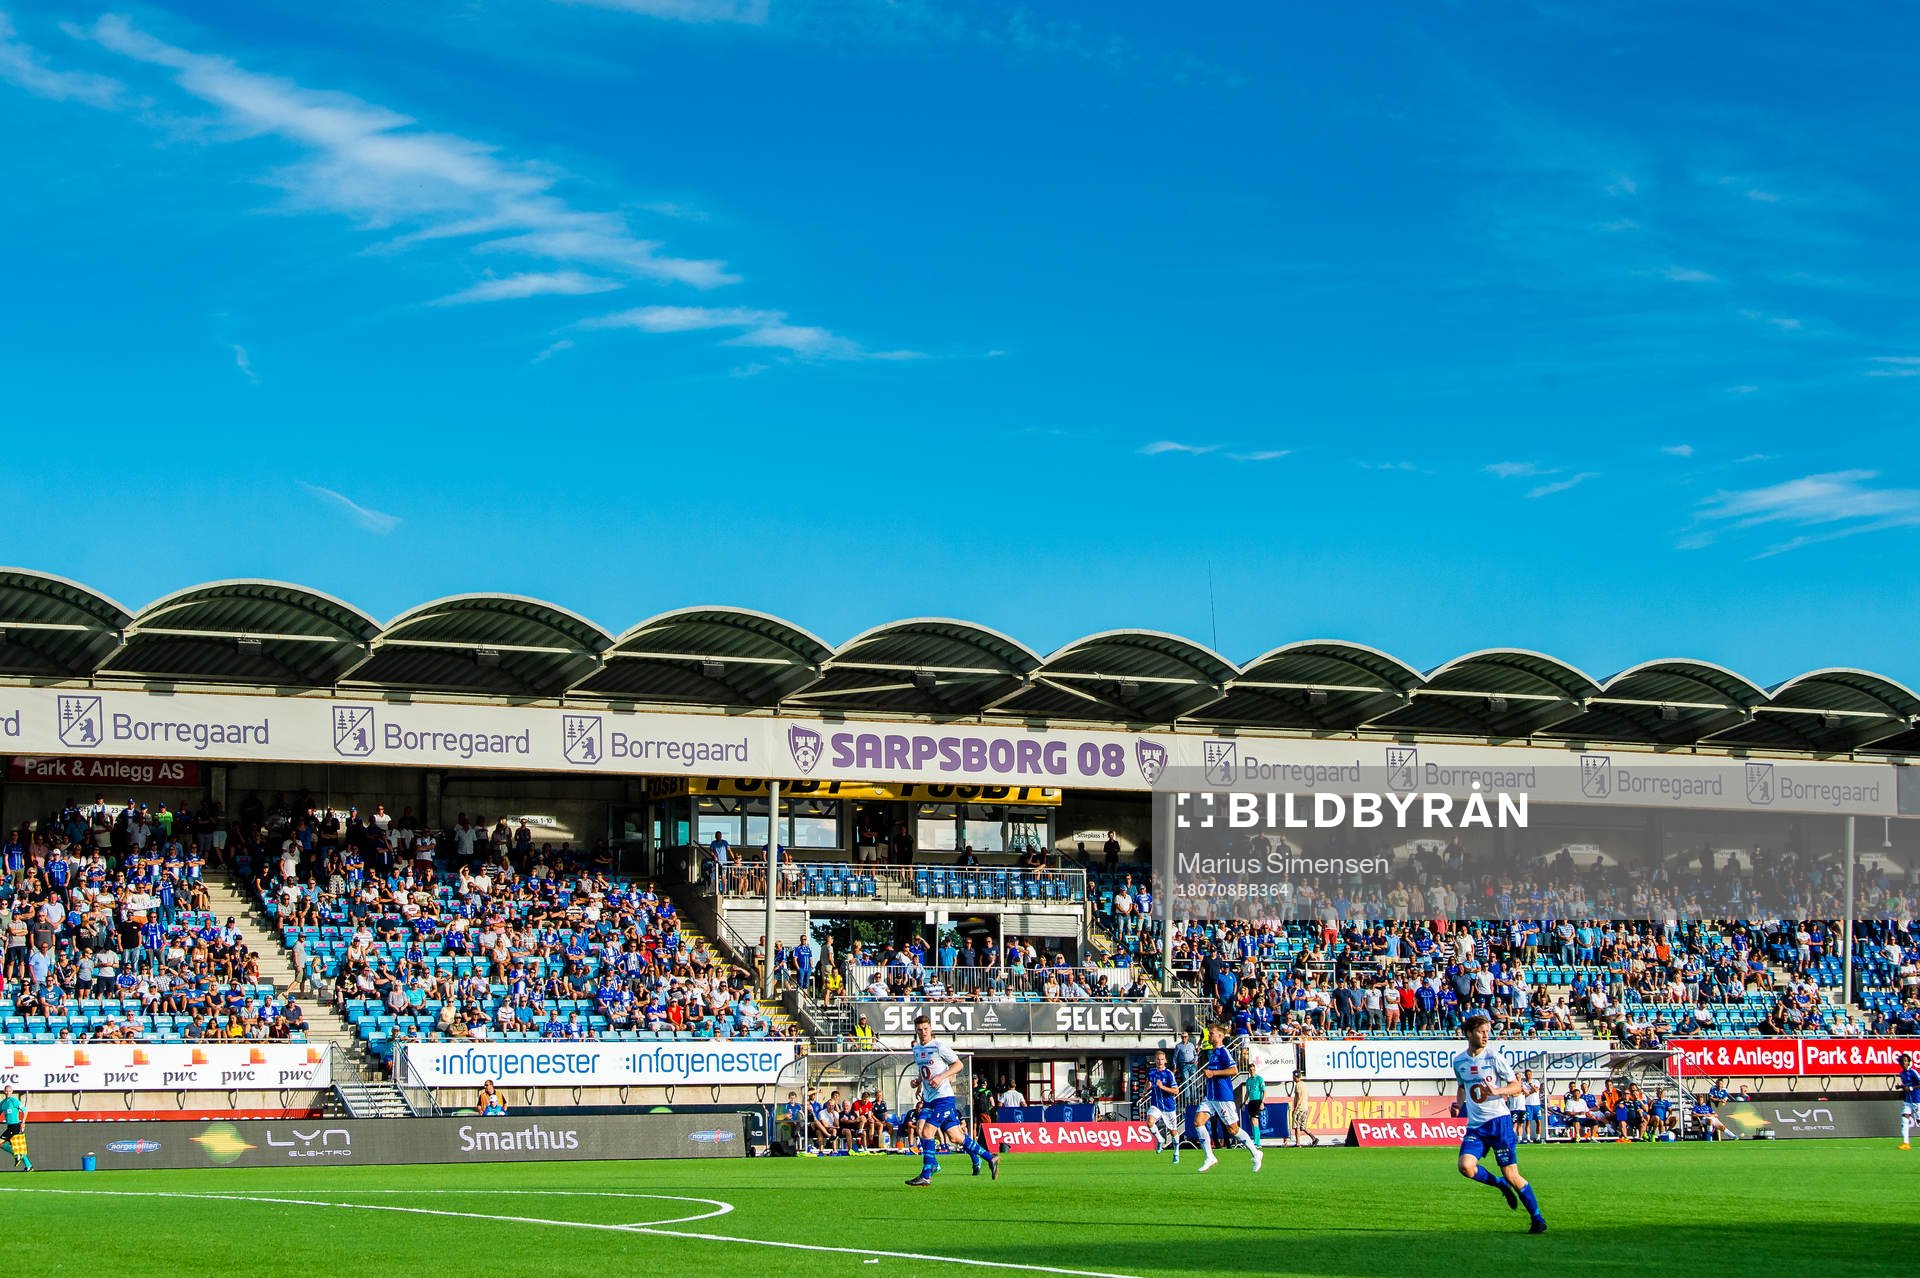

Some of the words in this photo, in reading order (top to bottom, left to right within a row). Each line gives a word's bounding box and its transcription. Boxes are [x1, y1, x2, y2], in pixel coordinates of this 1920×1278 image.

[112, 713, 270, 750] Borregaard
[384, 723, 530, 759] Borregaard
[611, 732, 748, 767] Borregaard
[831, 732, 1067, 776] SARPSBORG
[1077, 742, 1126, 778] 08
[24, 758, 68, 777] Park
[72, 760, 86, 777] &
[90, 760, 153, 782] Anlegg
[159, 763, 185, 780] AS
[1244, 757, 1361, 788] Borregaard
[1425, 762, 1536, 793] Borregaard
[1617, 770, 1723, 800] Borregaard
[1780, 777, 1880, 807] Borregaard
[1672, 1046, 1715, 1066] Park
[1717, 1046, 1730, 1066] &
[1733, 1046, 1795, 1070] Anlegg
[1806, 1046, 1850, 1065] Park
[1850, 1046, 1862, 1065] &
[0, 1073, 20, 1084] wc
[44, 1072, 80, 1087] pwc
[104, 1071, 139, 1086] pwc
[163, 1069, 198, 1086] pwc
[221, 1069, 256, 1085] pwc
[279, 1068, 313, 1084] pwc
[459, 1124, 579, 1152] Smarthus
[988, 1126, 1035, 1145] Park
[1038, 1126, 1054, 1145] &
[1057, 1125, 1122, 1147] Anlegg
[1126, 1124, 1153, 1143] AS
[1358, 1122, 1401, 1140] Park
[1403, 1122, 1418, 1139] &
[1421, 1121, 1467, 1141] Anleg
[288, 1149, 352, 1157] ELEKTRO
